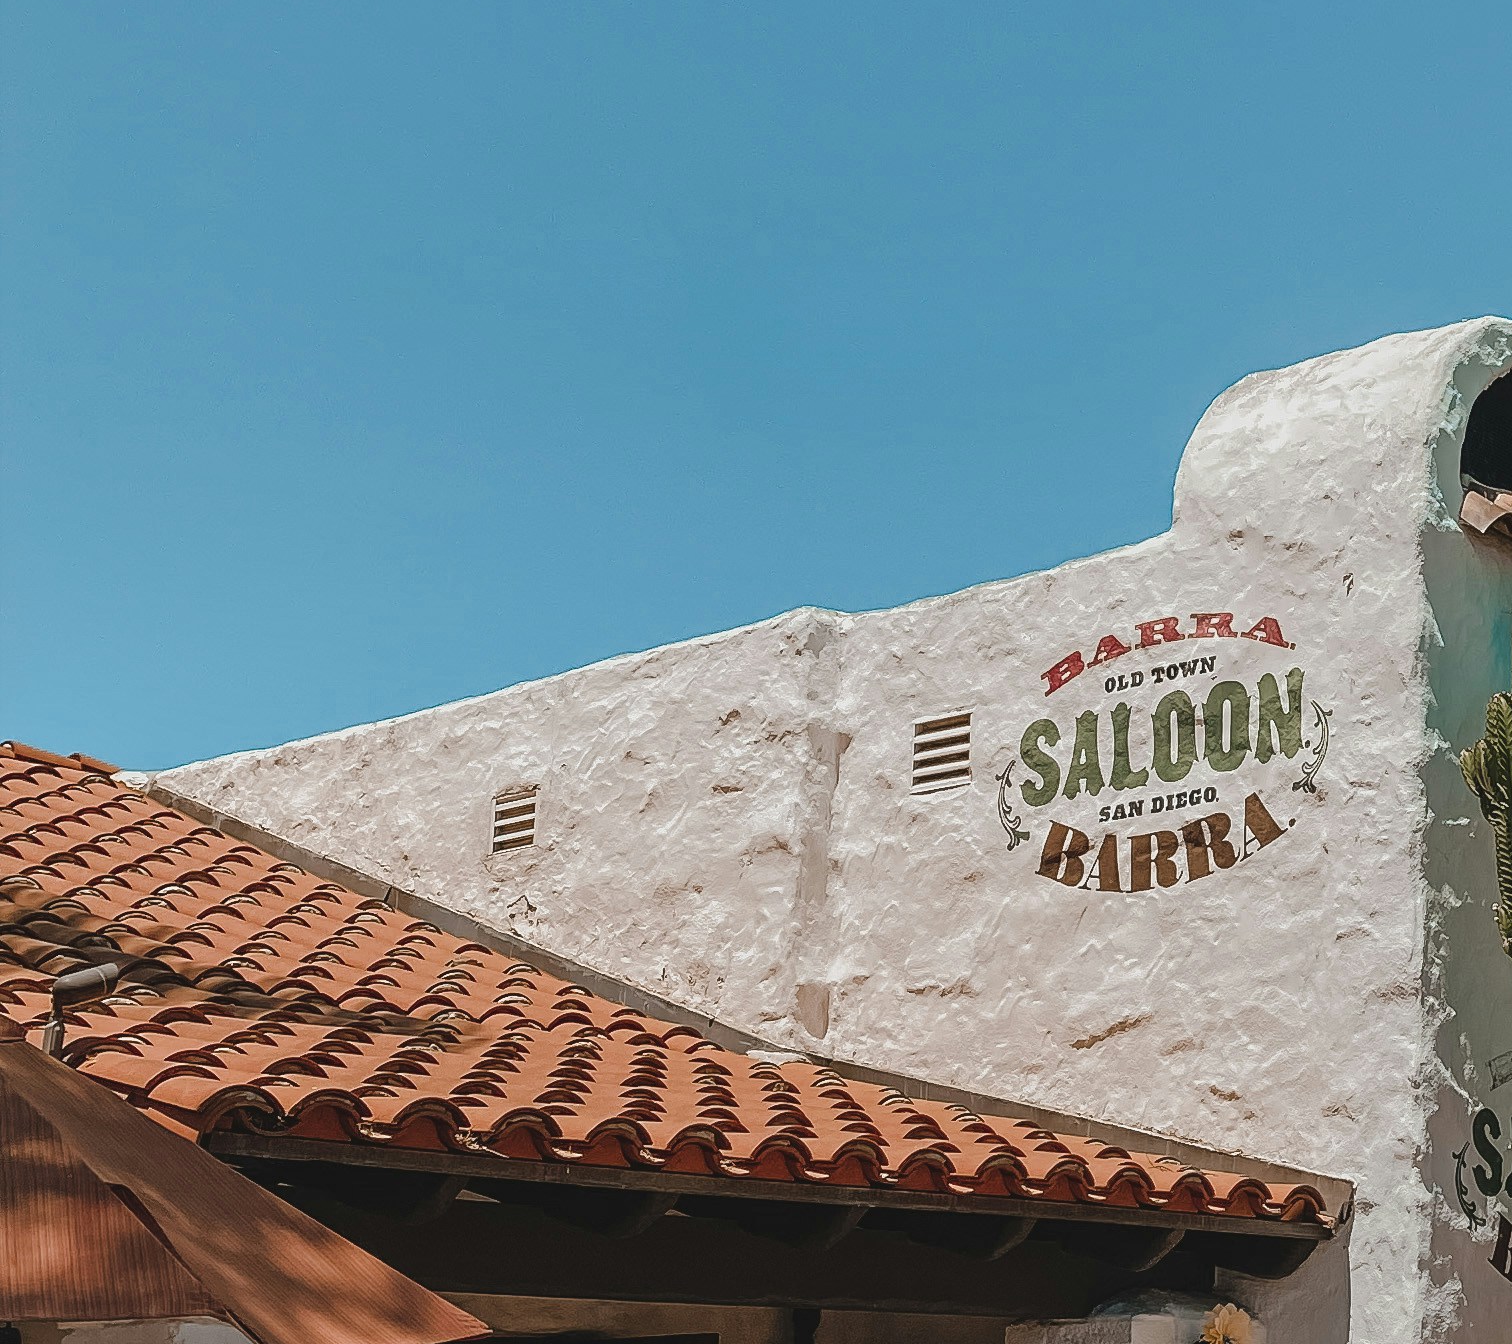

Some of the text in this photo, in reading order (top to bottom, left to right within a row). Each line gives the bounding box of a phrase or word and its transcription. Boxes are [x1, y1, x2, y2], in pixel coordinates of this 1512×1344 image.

[1104, 655, 1217, 694] OLD TOWN
[1098, 798, 1145, 824] SAN
